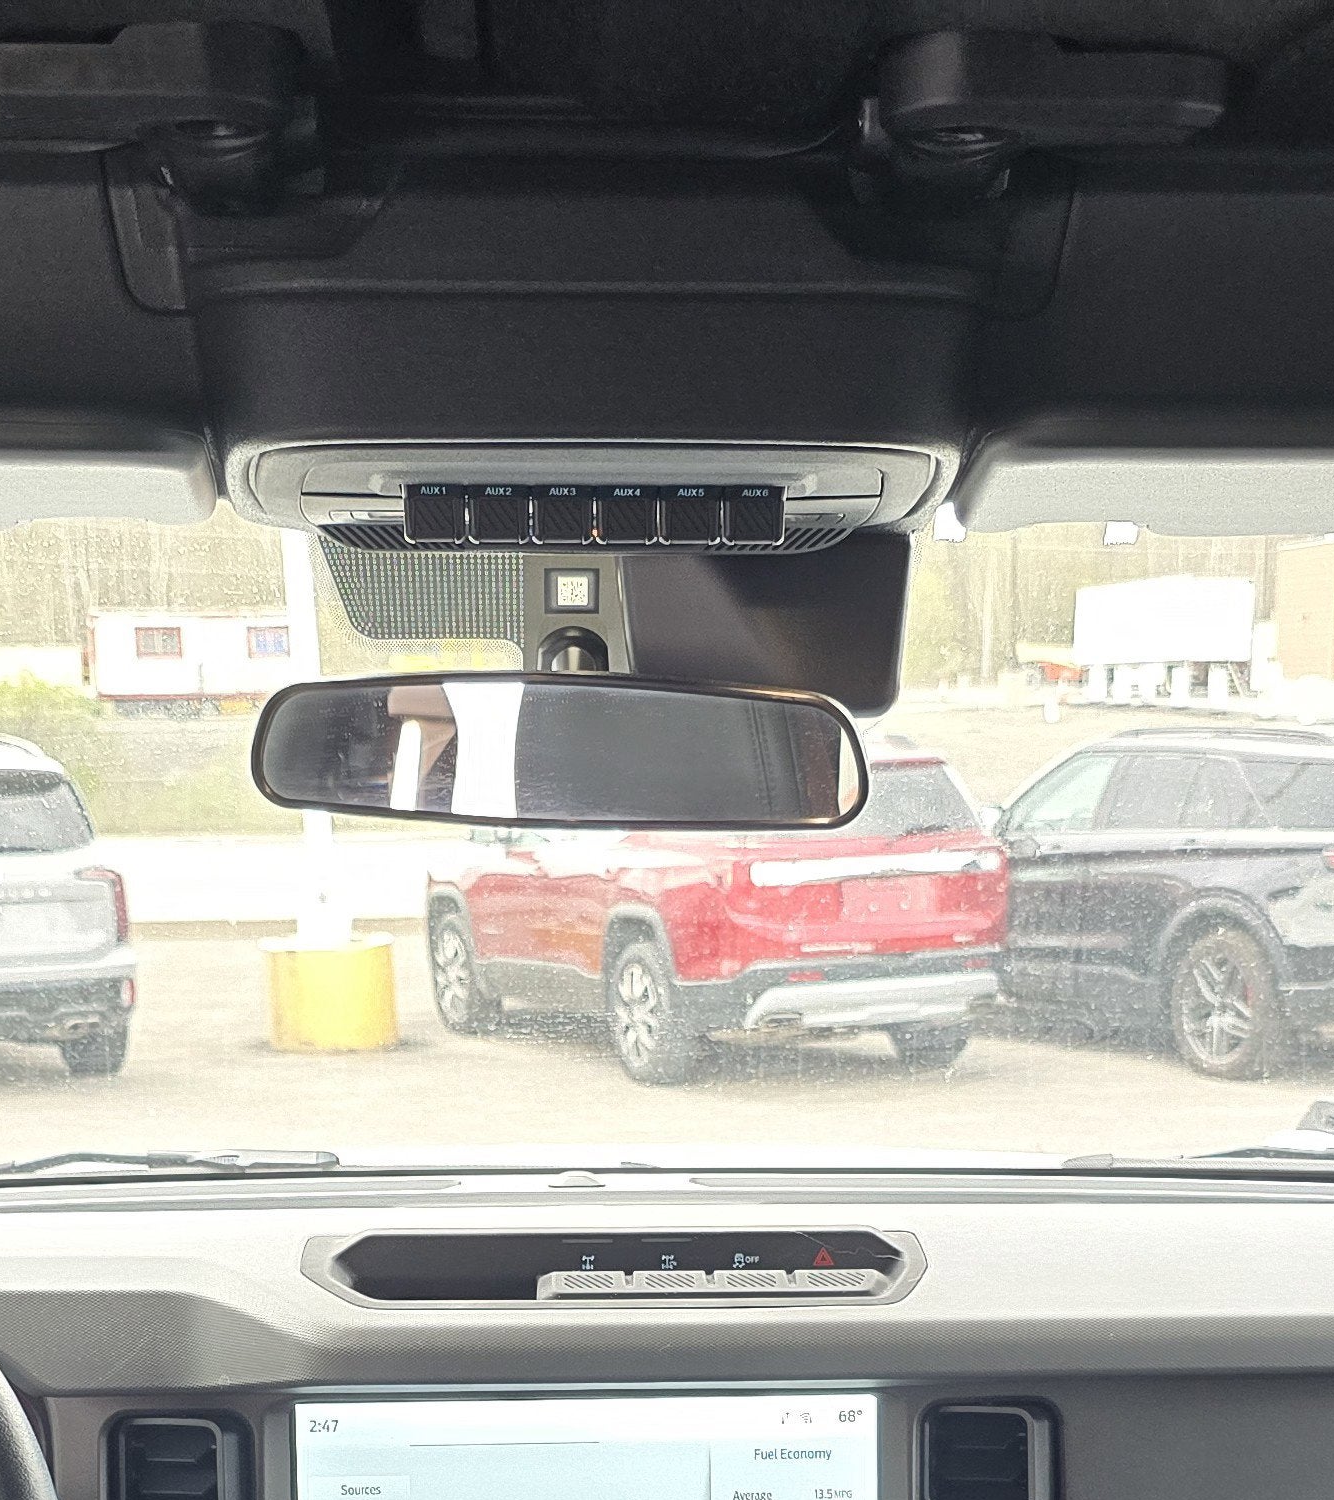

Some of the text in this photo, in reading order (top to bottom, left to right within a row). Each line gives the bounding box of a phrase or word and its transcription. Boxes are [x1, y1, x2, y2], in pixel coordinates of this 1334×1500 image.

[838, 1409, 863, 1424] 68°
[309, 1419, 339, 1434] 2:47
[754, 1448, 832, 1462] Fuel Economy
[340, 1484, 382, 1496] Sources
